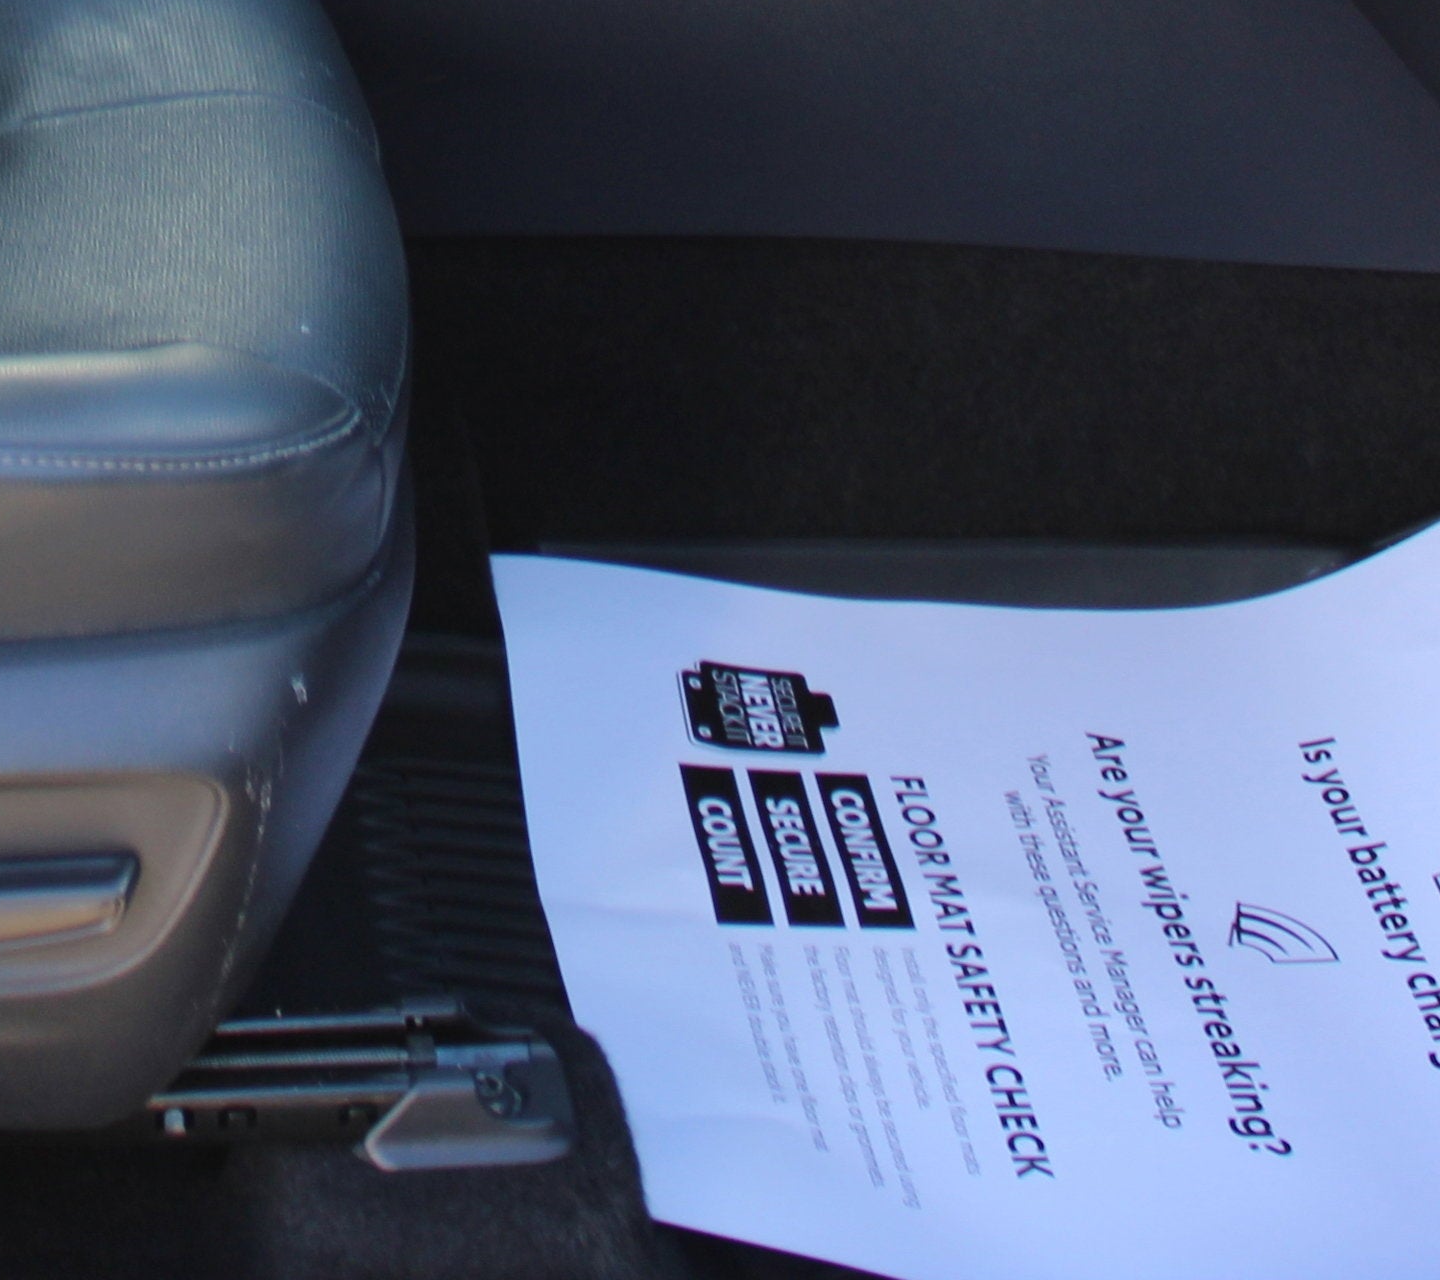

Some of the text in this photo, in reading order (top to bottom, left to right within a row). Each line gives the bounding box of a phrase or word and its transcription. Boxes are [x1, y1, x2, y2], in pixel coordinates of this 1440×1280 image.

[711, 668, 746, 727] STACK
[737, 672, 785, 746] NEVER
[771, 676, 809, 749] SECURE IT
[1299, 737, 1336, 764] Is
[698, 798, 755, 892] COUNT
[765, 797, 826, 897] SECURE
[831, 789, 898, 911] CONFIRM
[1305, 768, 1368, 837] your
[1004, 791, 1123, 1082] with these questions and more.
[1027, 754, 1185, 1129] Your Assistant Service Manager can help
[1086, 733, 1292, 1156] Are your wipers streaking?
[1347, 841, 1426, 962] battery
[890, 776, 1054, 1178] FLOOR MAT SAFETY CHECK
